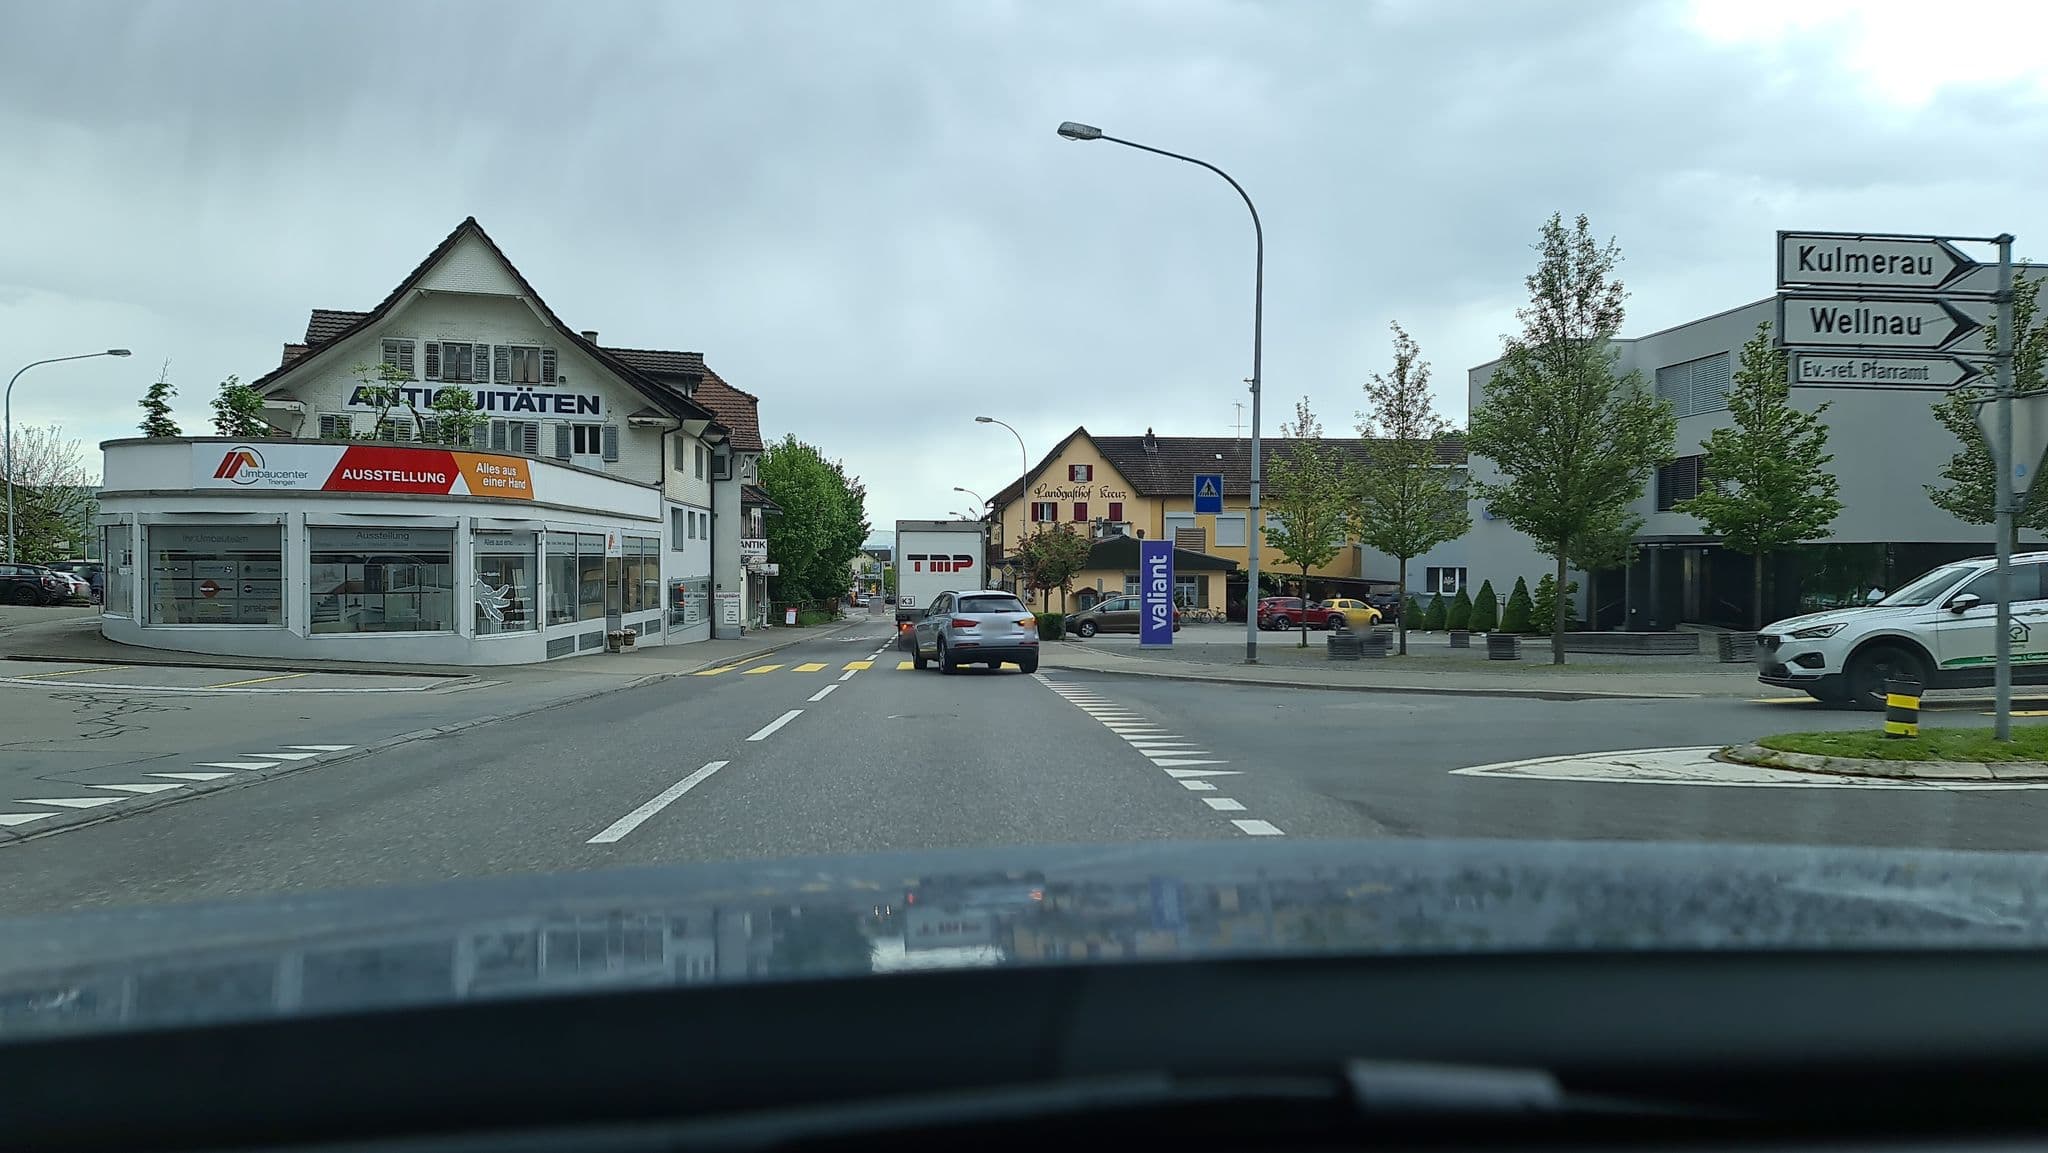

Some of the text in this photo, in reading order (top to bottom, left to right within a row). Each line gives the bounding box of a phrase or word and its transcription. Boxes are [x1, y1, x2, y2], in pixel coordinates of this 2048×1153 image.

[1798, 244, 1933, 276] Kulmerau
[1810, 306, 1922, 336] Wellnau
[1803, 360, 1930, 380] Ev.-ref. Pfarramt
[240, 469, 309, 480] Umbaucenter
[342, 468, 446, 485] AUSSTELLUNG
[476, 461, 517, 476] Alles aus
[482, 475, 526, 490] einer Hand
[1034, 483, 1127, 502] Landgasthof Kreuz
[356, 531, 410, 541] Ausstellung
[907, 554, 974, 573] TMP
[901, 597, 914, 606] K3
[1147, 555, 1168, 631] valiant
